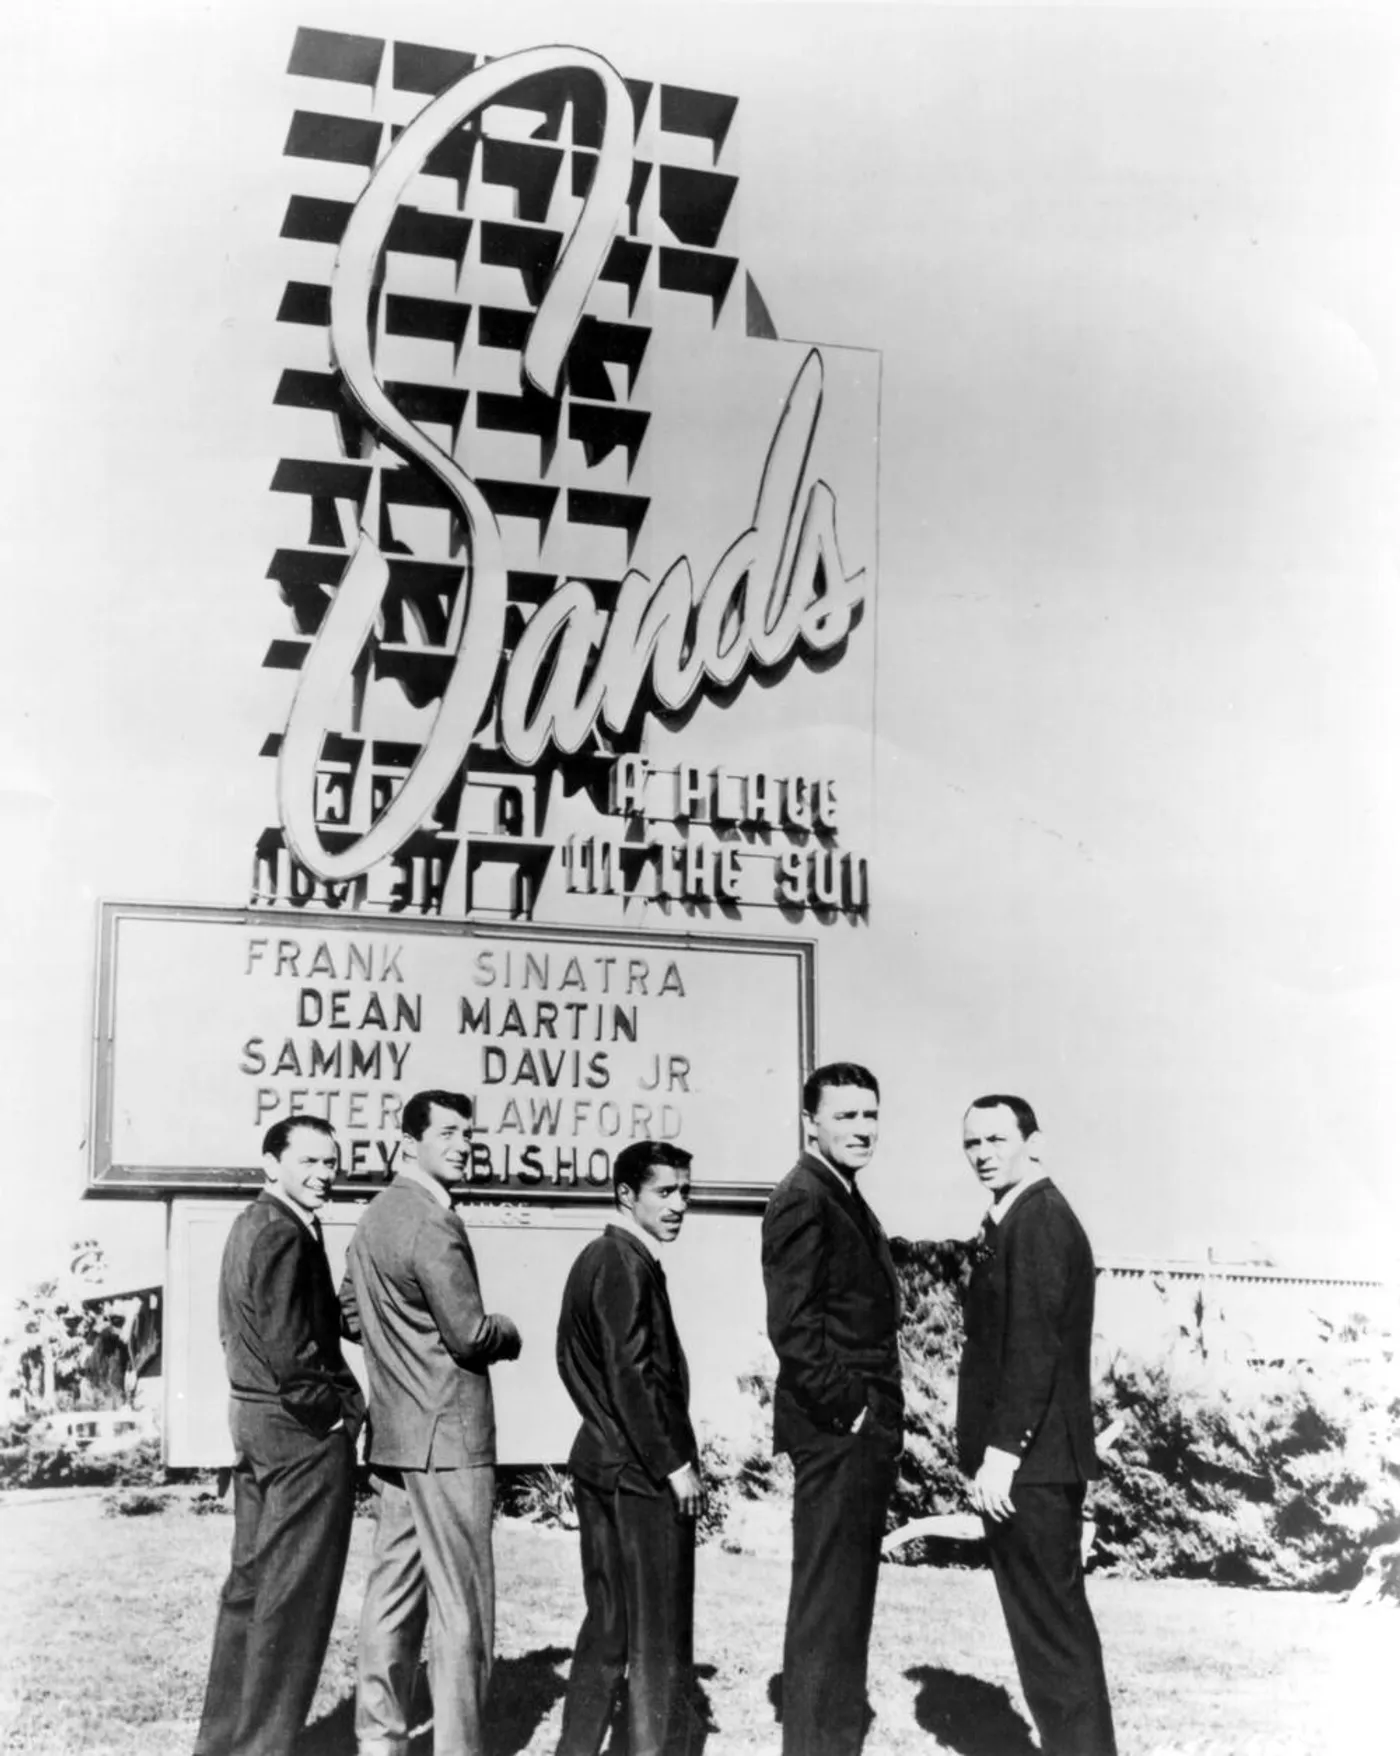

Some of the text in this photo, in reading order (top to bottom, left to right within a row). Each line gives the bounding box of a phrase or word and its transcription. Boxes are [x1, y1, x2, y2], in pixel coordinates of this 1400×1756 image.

[276, 44, 866, 880] Sands
[774, 850, 869, 911] SUN
[245, 938, 686, 998] FRANK SINATRA
[297, 986, 638, 1043] DEAN MARTIN
[239, 1035, 412, 1081] SAMMY
[482, 1044, 610, 1089] DAVIS
[254, 1087, 683, 1141] PETER LAWFORD
[467, 1142, 613, 1187] BISHO
